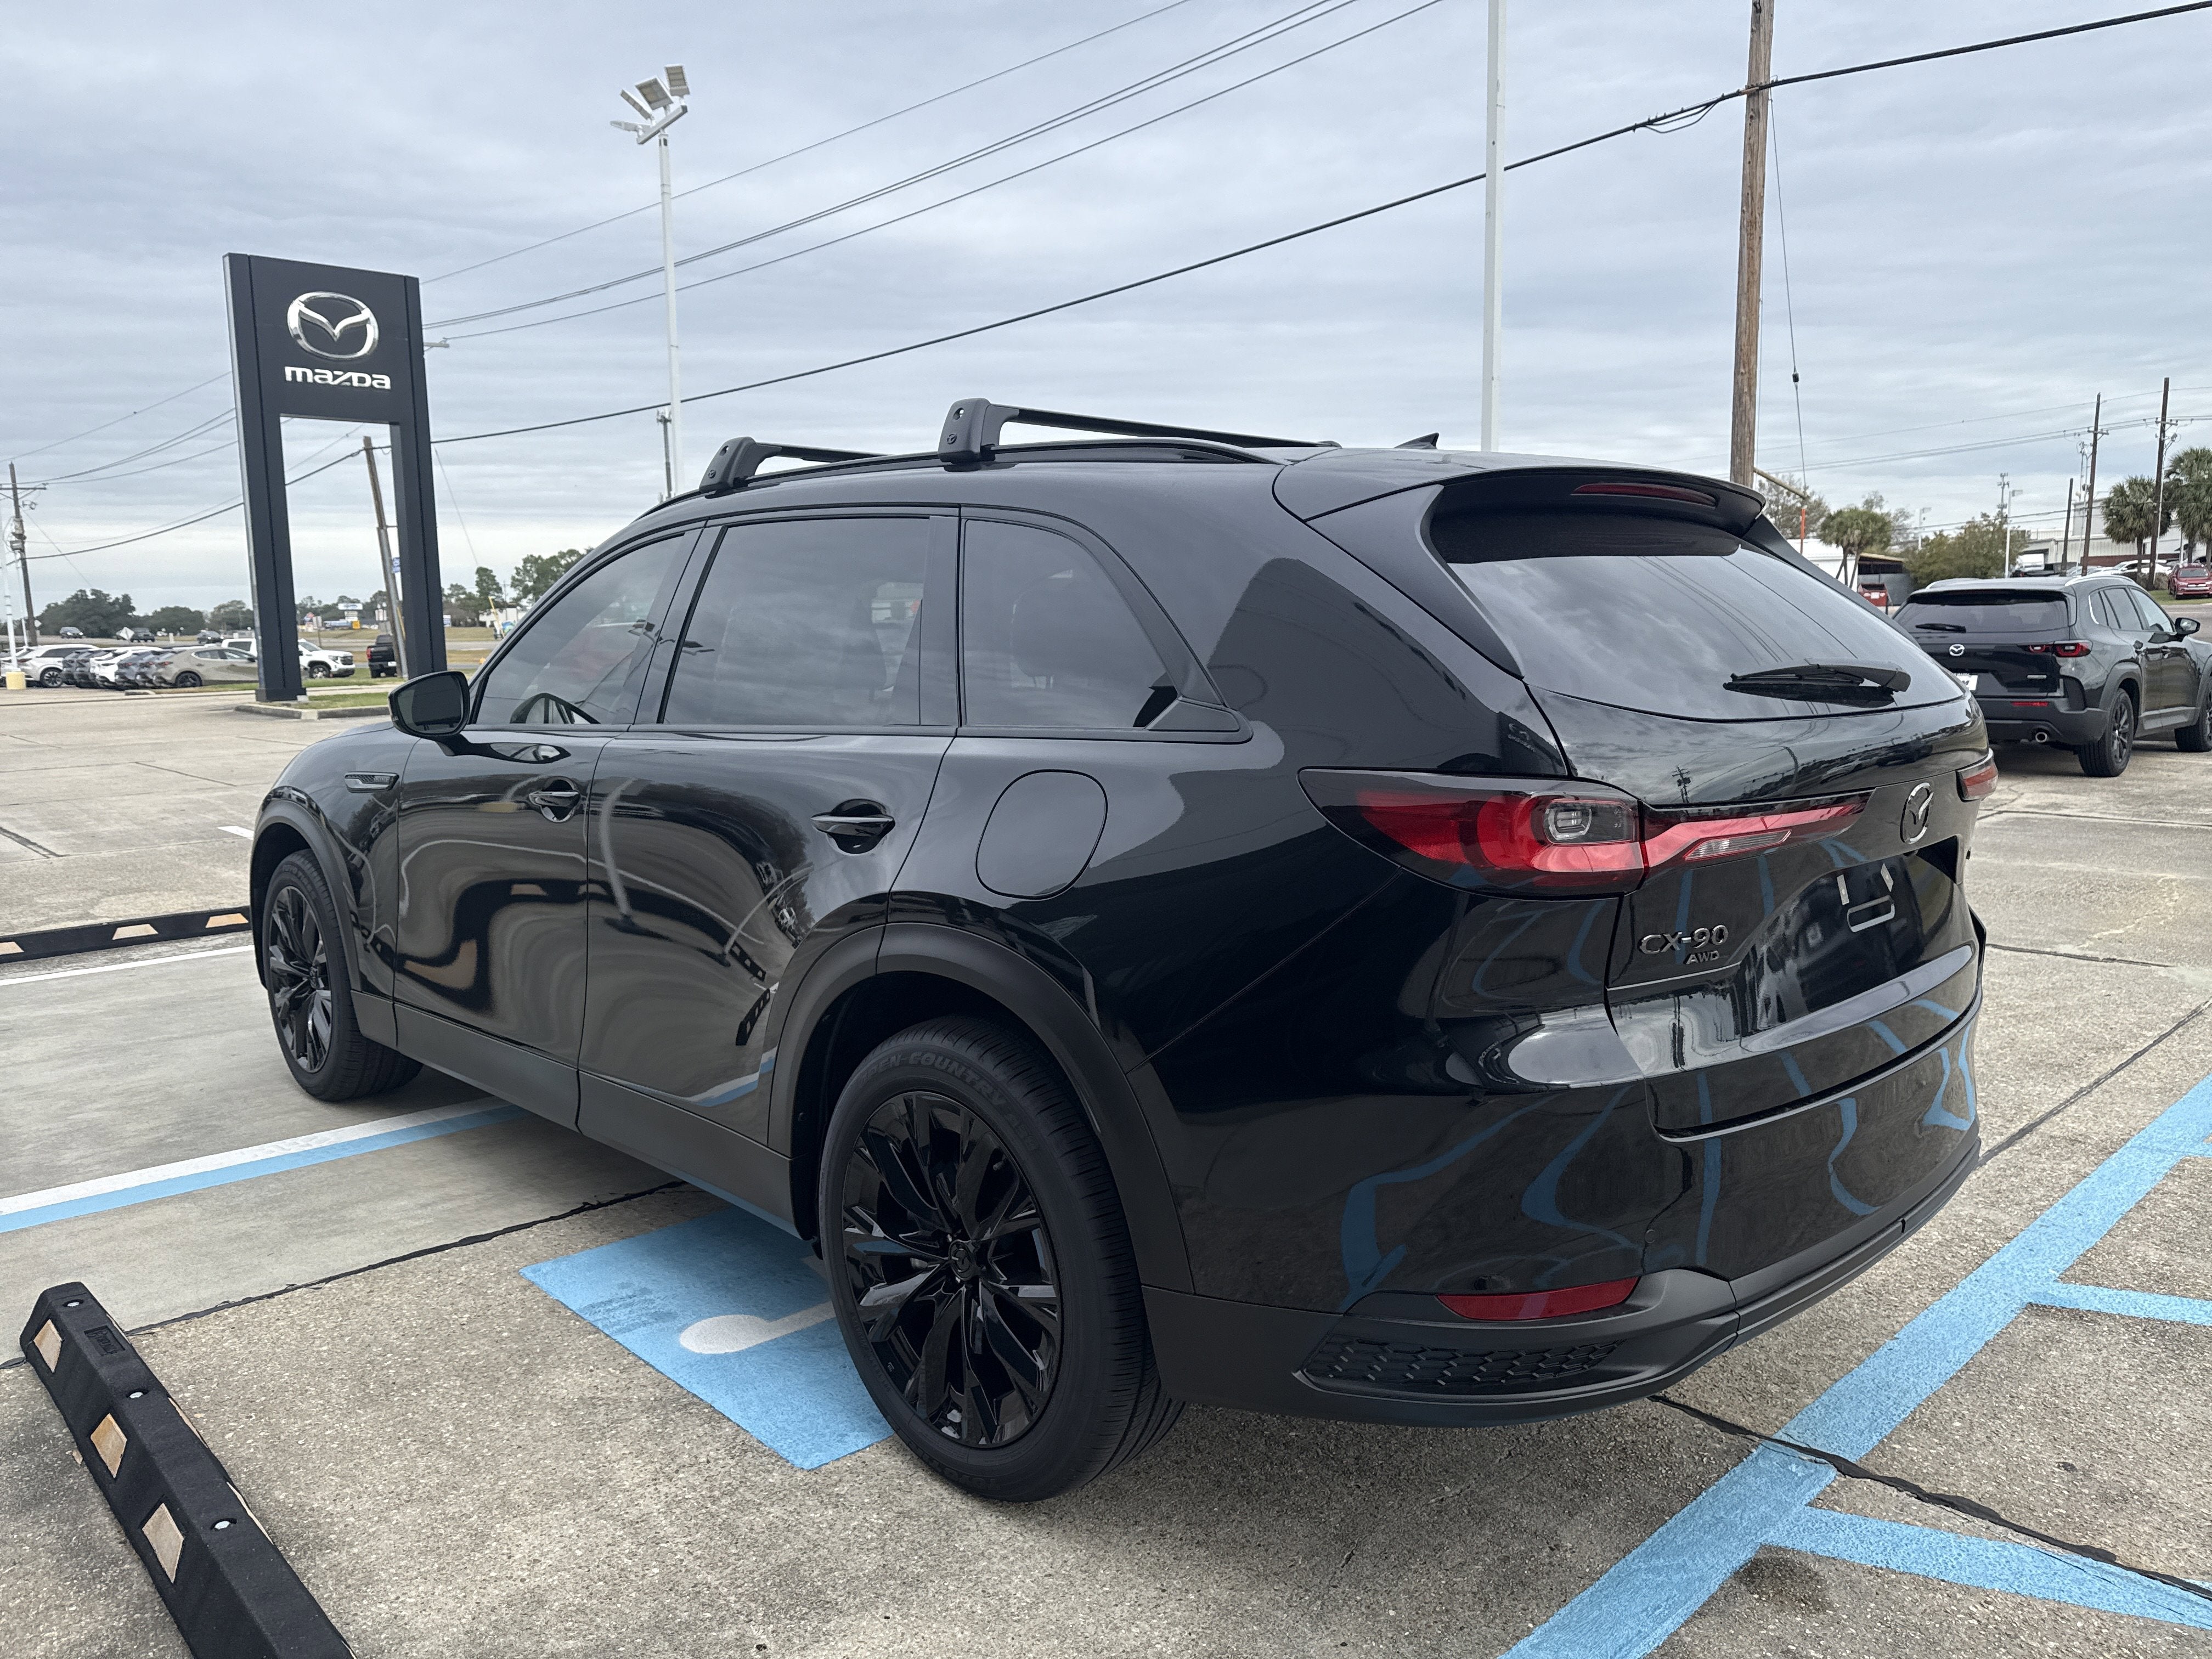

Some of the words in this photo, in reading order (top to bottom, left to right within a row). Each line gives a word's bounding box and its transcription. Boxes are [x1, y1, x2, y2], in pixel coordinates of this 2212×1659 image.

[284, 366, 391, 390] mazda
[1639, 924, 1729, 955] CX-90
[1685, 950, 1720, 964] AWD
[909, 1052, 1008, 1105] COUNTRY
